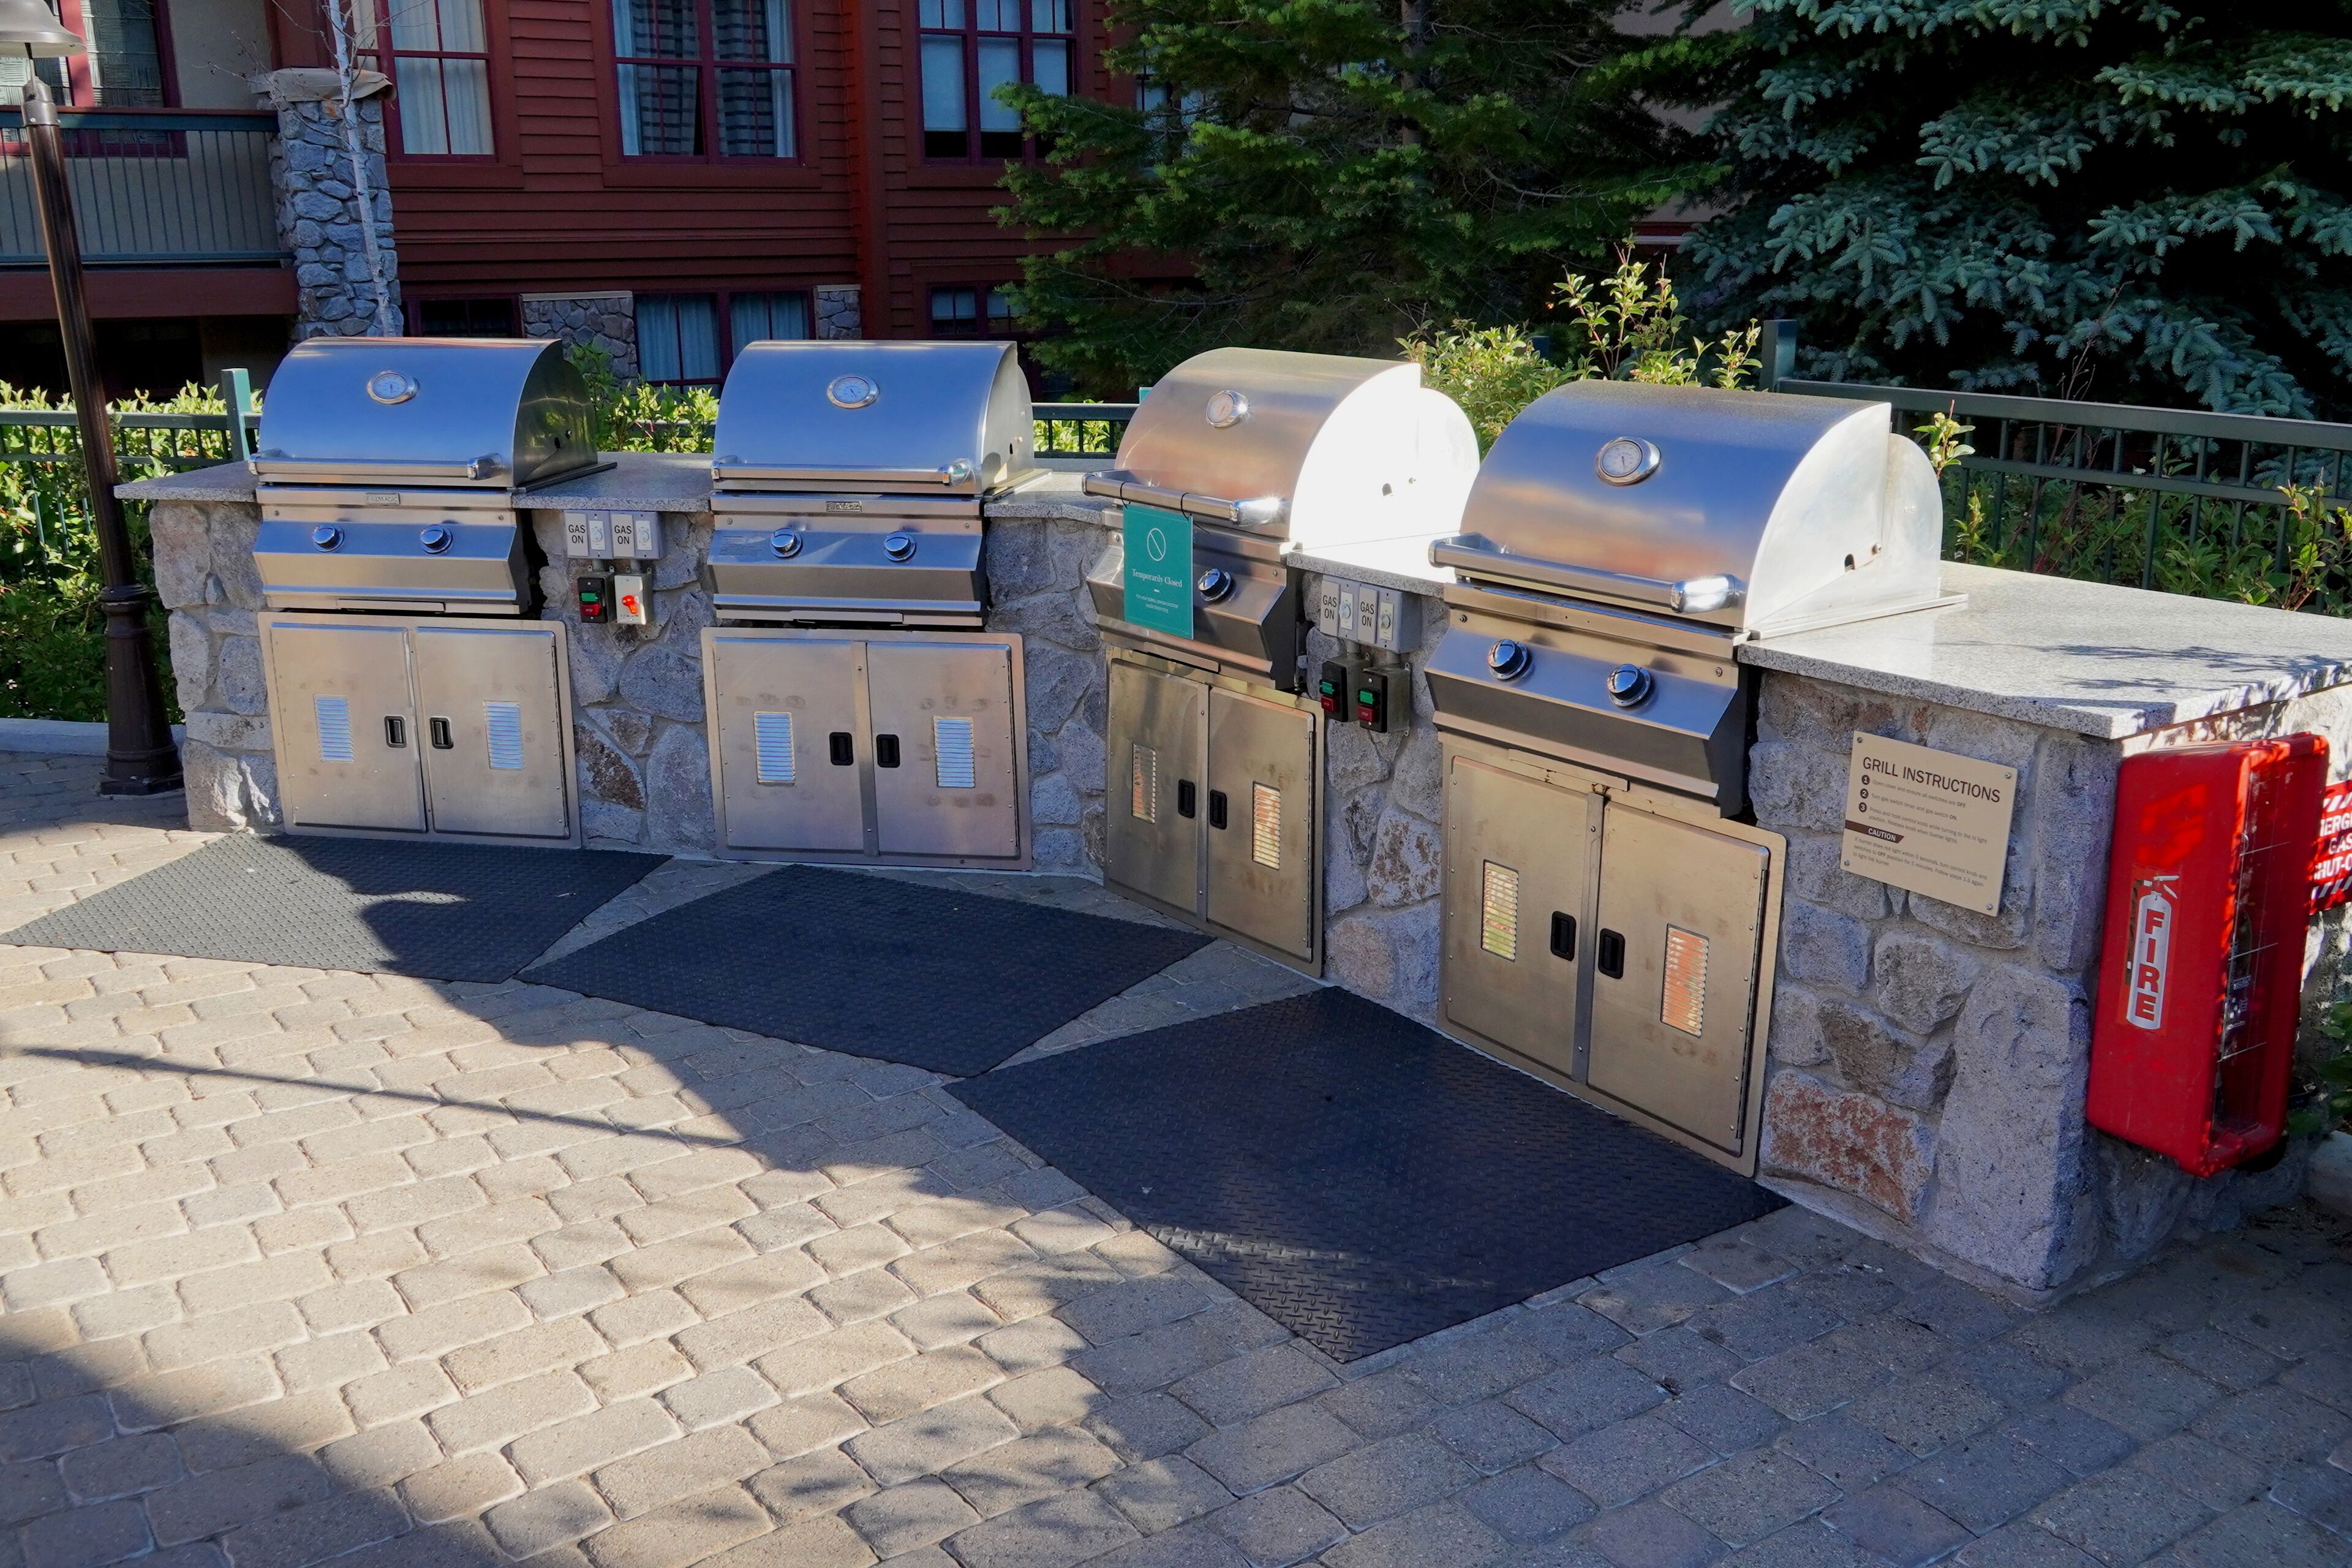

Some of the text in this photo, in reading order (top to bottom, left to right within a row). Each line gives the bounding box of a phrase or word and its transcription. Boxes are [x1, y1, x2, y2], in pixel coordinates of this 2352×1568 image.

[568, 524, 586, 533] GAS
[614, 525, 632, 534] GAS
[571, 535, 584, 544] ON
[617, 535, 630, 545] ON
[1132, 568, 1183, 588] Temporarily Closed
[1322, 595, 1337, 608] GAS
[1360, 601, 1374, 615] GAS
[1324, 608, 1335, 620] ON
[1362, 615, 1372, 627] ON
[1863, 757, 2000, 803] GRILL INSTRUCTIONS
[1868, 827, 1896, 841] CAUTION
[2329, 833, 2352, 855] GAS
[2313, 853, 2352, 880] HUT-O
[2135, 908, 2165, 1022] FIRE
